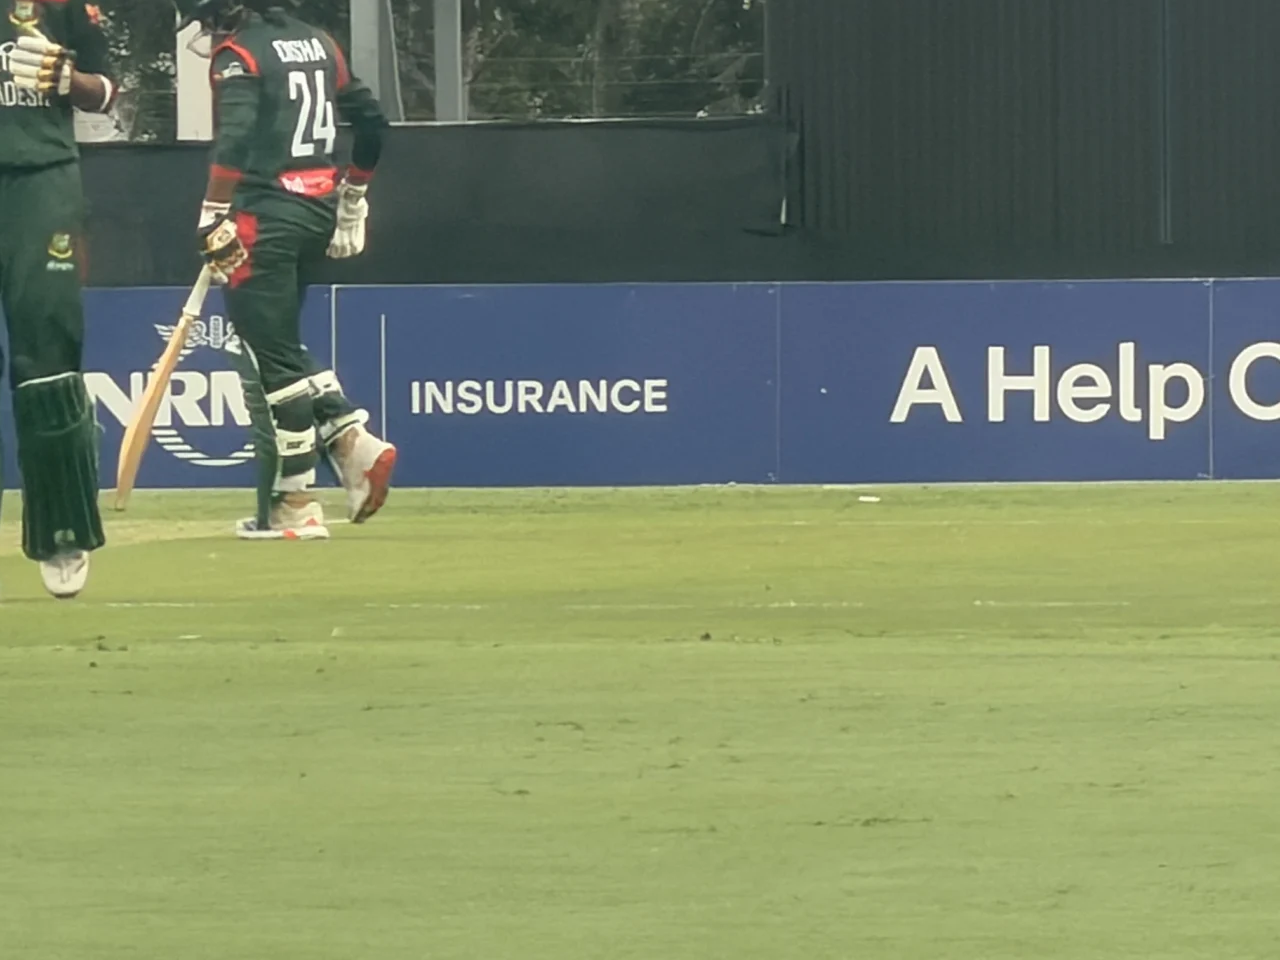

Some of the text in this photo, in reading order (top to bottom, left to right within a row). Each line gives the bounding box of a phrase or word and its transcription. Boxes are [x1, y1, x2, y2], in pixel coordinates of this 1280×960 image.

[288, 69, 336, 157] 24
[82, 370, 668, 426] NRM INSURANCE
[889, 346, 963, 423] A
[987, 342, 1205, 440] Help
